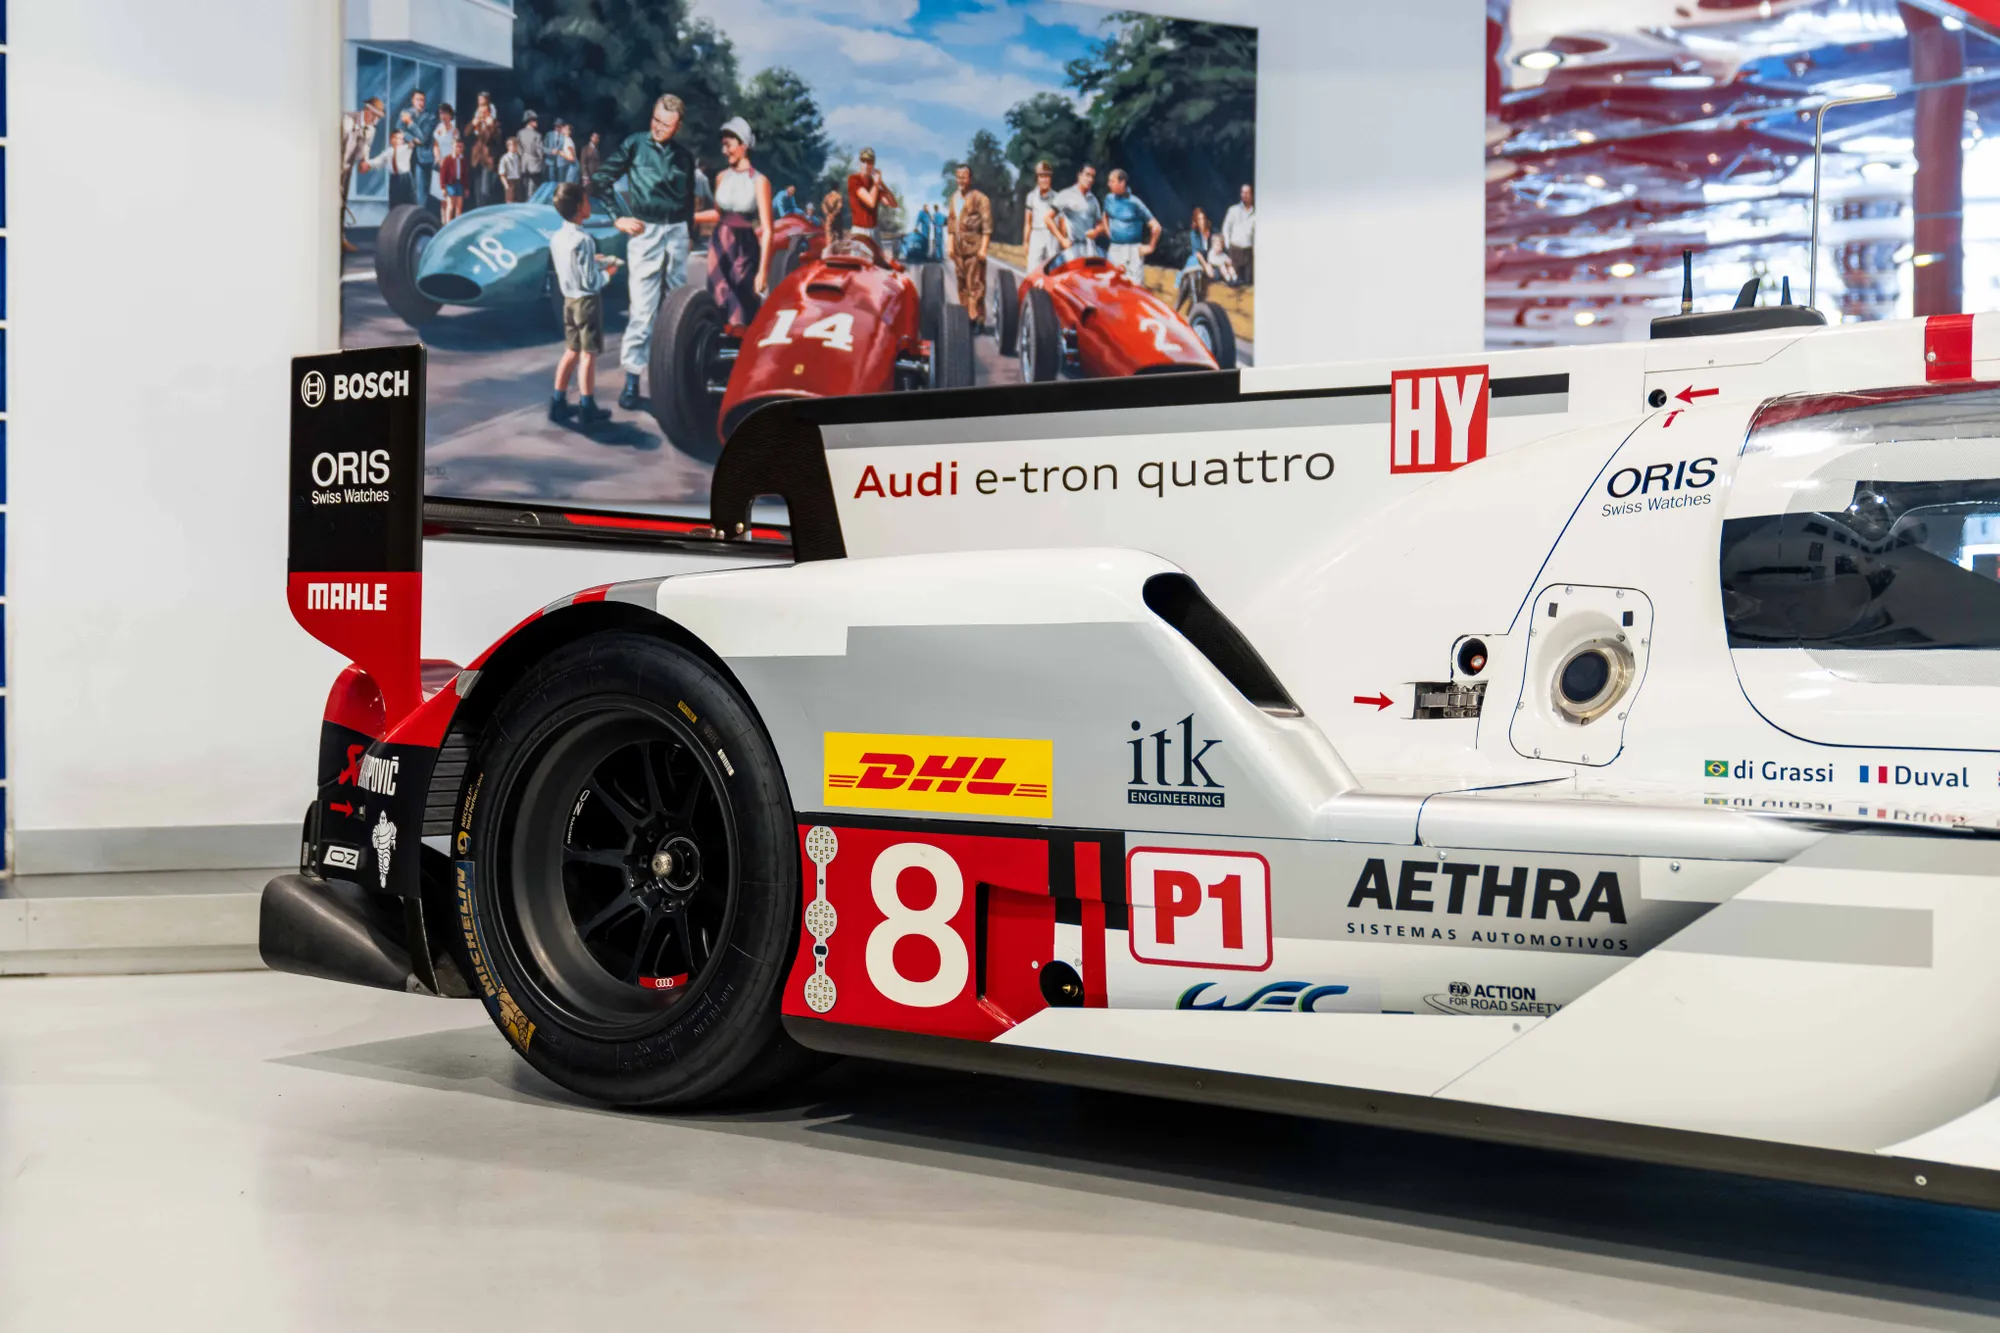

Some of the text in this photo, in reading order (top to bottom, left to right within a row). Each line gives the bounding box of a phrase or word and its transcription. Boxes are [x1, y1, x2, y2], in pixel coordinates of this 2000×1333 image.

[468, 236, 518, 273] 18
[758, 309, 854, 352] 14
[1139, 318, 1183, 353] 2
[334, 370, 410, 400] BOSCH
[1394, 373, 1485, 467] HY
[312, 450, 390, 487] ORIS
[854, 449, 1336, 499] Audi e-tron quattro
[1607, 457, 1718, 498] ORIS
[311, 488, 389, 504] Swiss Watches
[1601, 494, 1711, 517] Swiss Watches
[307, 583, 387, 611] MAHLE
[1127, 712, 1225, 788] itk
[855, 752, 1016, 796] DHL
[1734, 760, 1834, 782] di Grassi
[1895, 766, 1969, 788] Duval
[1130, 791, 1223, 806] ENGINEERING
[330, 850, 356, 866] OZ
[1347, 858, 1627, 924] AETHRA
[865, 842, 969, 1008] 8
[1153, 870, 1243, 949] P1
[457, 867, 496, 998] MICHELIN
[1347, 922, 1629, 951] SISTEMAS AUTOMOTIVOS
[1449, 998, 1563, 1014] FOR ROAD SAFETY
[1450, 984, 1536, 1001] FIA ACTION
